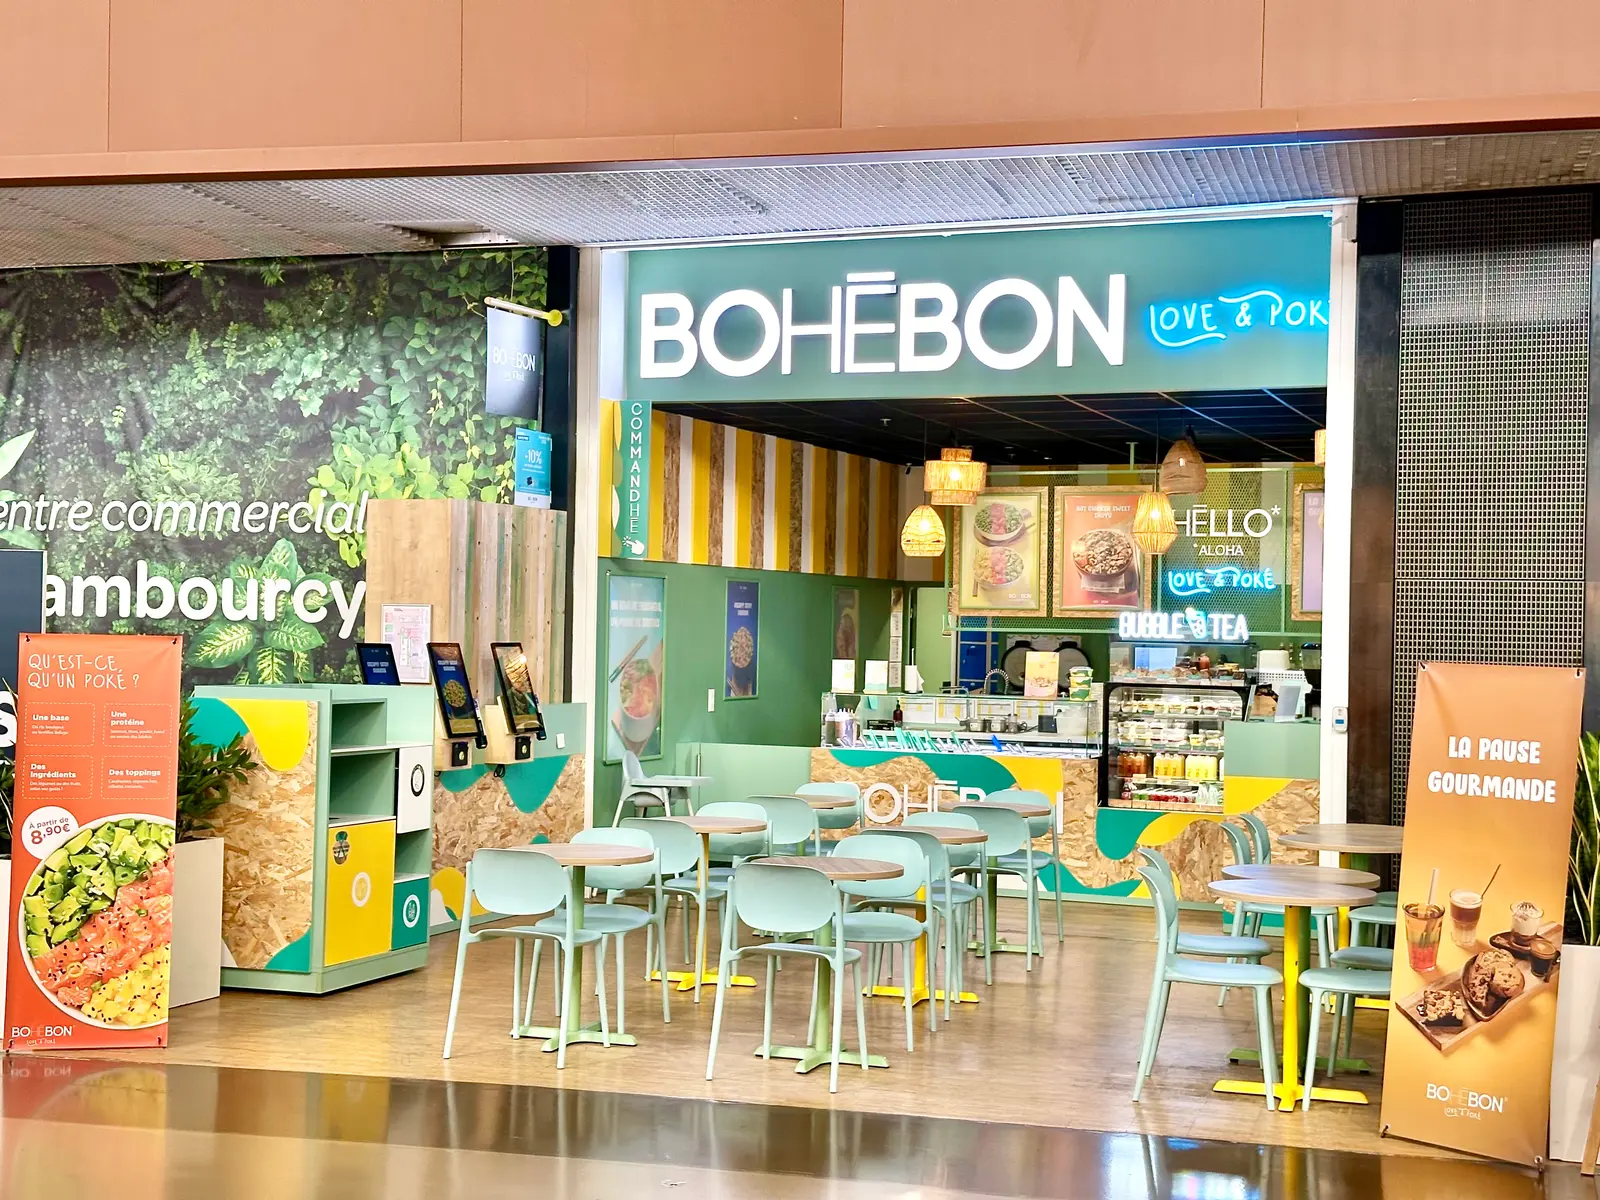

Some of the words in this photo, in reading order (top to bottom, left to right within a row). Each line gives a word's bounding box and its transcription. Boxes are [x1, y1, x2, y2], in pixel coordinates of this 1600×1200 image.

[1218, 290, 1330, 326] POK
[1235, 302, 1251, 327] &
[1150, 302, 1226, 347] LOVE
[525, 449, 542, 465] -10%
[0, 493, 94, 532] ntre
[101, 489, 369, 534] commercial
[1168, 571, 1211, 596] LOVE
[1205, 566, 1276, 589] POKÉ
[1214, 572, 1225, 587] &
[45, 559, 367, 639] ambourcy
[1119, 611, 1185, 640] BUBBLE
[1208, 613, 1249, 642] TEA
[27, 673, 75, 689] QU'UN
[84, 669, 127, 690] POKÉ
[132, 674, 140, 688] ?
[111, 718, 145, 727] protéine
[1448, 736, 1471, 758] LA
[1478, 737, 1541, 764] PAUSE
[125, 769, 161, 777] toppings
[1427, 771, 1556, 803] GOURMANDE
[30, 823, 71, 845] 8,90€
[36, 819, 58, 829] partir
